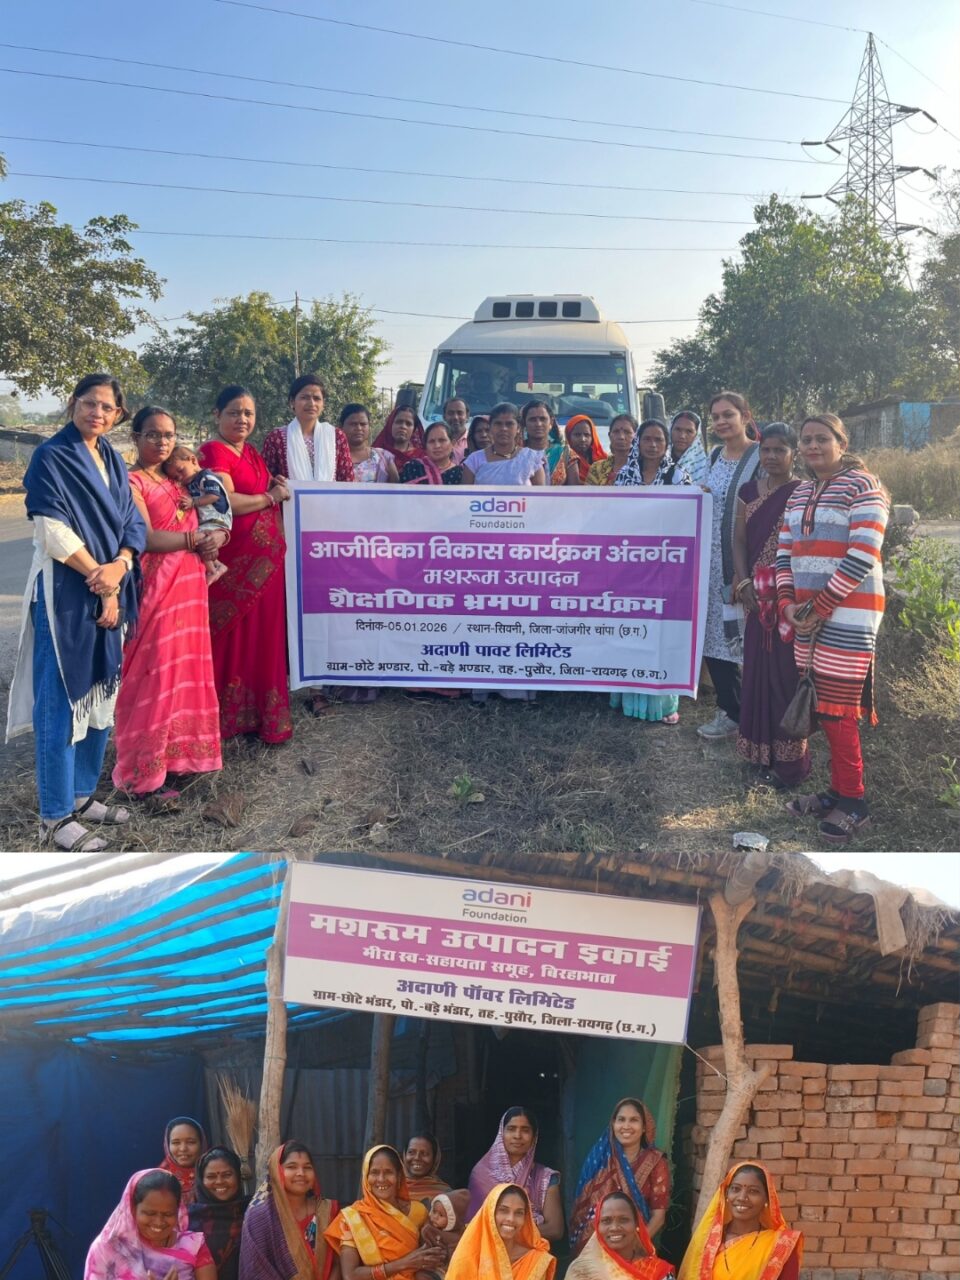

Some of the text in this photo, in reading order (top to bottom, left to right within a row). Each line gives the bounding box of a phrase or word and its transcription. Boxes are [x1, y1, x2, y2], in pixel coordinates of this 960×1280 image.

[469, 497, 526, 513] adani
[469, 519, 525, 529] Foundation
[309, 535, 688, 564] आजीविका विकास कार्यक्रम अंतर्गत
[423, 569, 581, 587] मशरूम उत्पादन
[329, 587, 668, 615] शैक्षणिक भ्रमण कार्यक्रम
[420, 641, 572, 659] अदाणी पावर लिमिटेड
[461, 887, 532, 908] adani
[462, 908, 528, 924] Foundation
[308, 912, 673, 973] मशरूम उत्पादन इकाई
[398, 951, 488, 972] स्व-सहायता
[396, 978, 577, 1010] अदाणी पॉवर लिमिटेड
